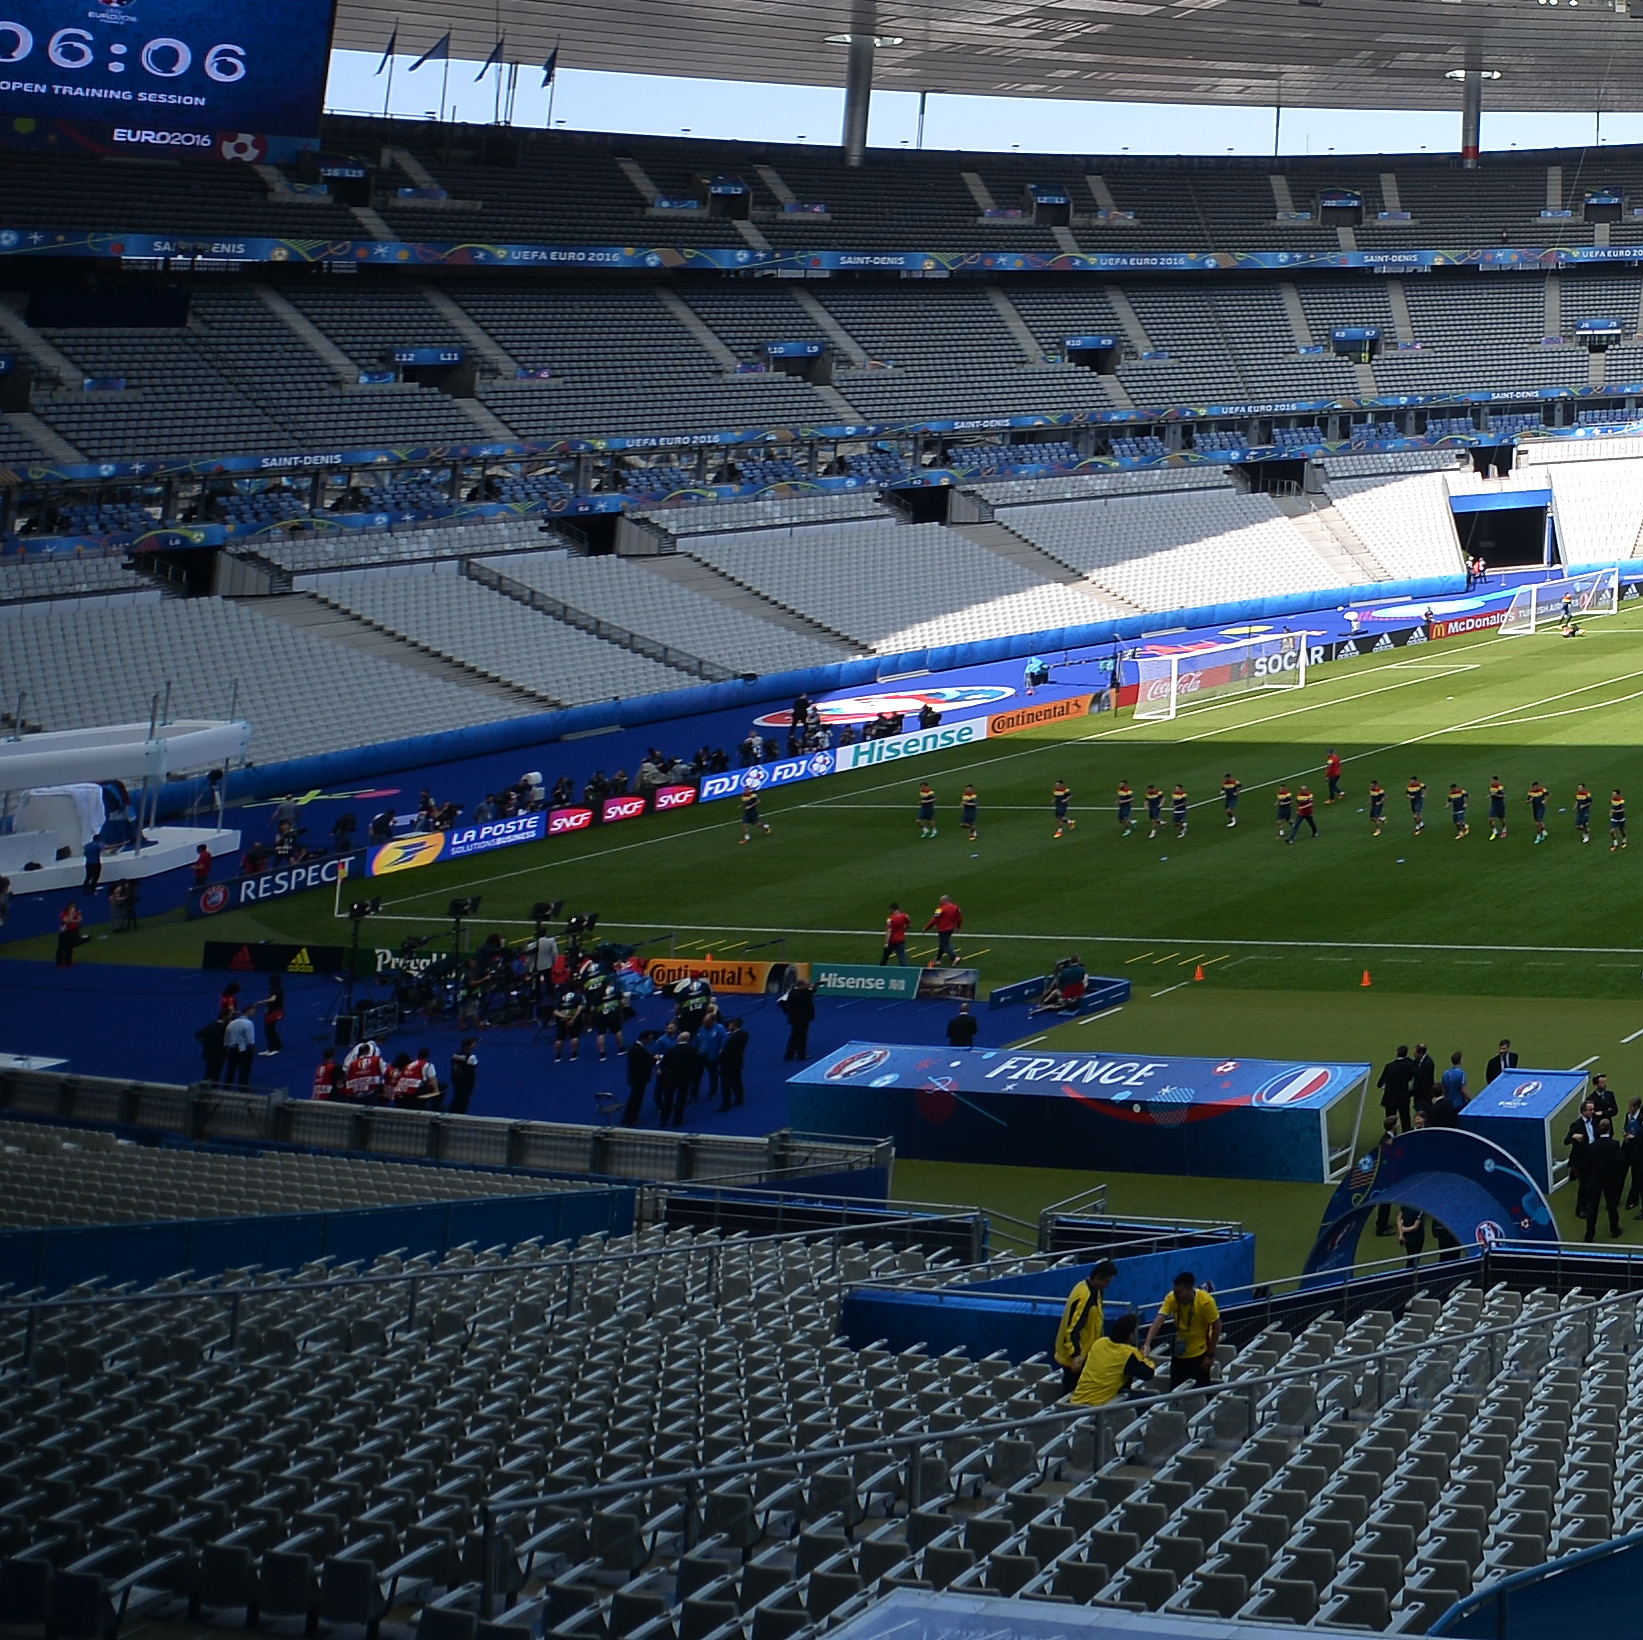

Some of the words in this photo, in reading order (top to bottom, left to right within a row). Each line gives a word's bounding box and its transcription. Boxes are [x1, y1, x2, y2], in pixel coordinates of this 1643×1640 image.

[0, 81, 47, 94] OPEN
[52, 85, 132, 100] TRAINING
[137, 92, 206, 107] SESSION
[113, 128, 212, 147] EURO2016
[511, 250, 547, 261] UEFA
[550, 251, 586, 262] EURO
[588, 252, 620, 262] 2016
[842, 256, 905, 266] SAINT-DENIS
[1100, 257, 1127, 266] UEFA
[1129, 257, 1157, 266] EURO
[1159, 256, 1184, 265] 2016
[1363, 255, 1418, 263] SAINT-DENIS
[1582, 250, 1606, 258] UEFA
[1607, 249, 1630, 257] EURO
[625, 437, 656, 448] UEFA
[659, 436, 690, 446] EURO
[691, 434, 720, 444] 2016
[261, 455, 342, 468] SAINT-DENIS
[990, 702, 1073, 734] Continental
[851, 724, 973, 767] Hisense
[771, 759, 808, 783] FDJ
[701, 774, 741, 799] FDJ
[656, 789, 696, 809] SNCF
[604, 799, 647, 820] SNCF
[452, 829, 477, 846] LA
[479, 816, 541, 839] POSTE
[550, 811, 593, 832] SNCF
[240, 856, 356, 903] RESPECT
[819, 972, 886, 991] Hisense
[984, 1056, 1169, 1087] FRANCE
